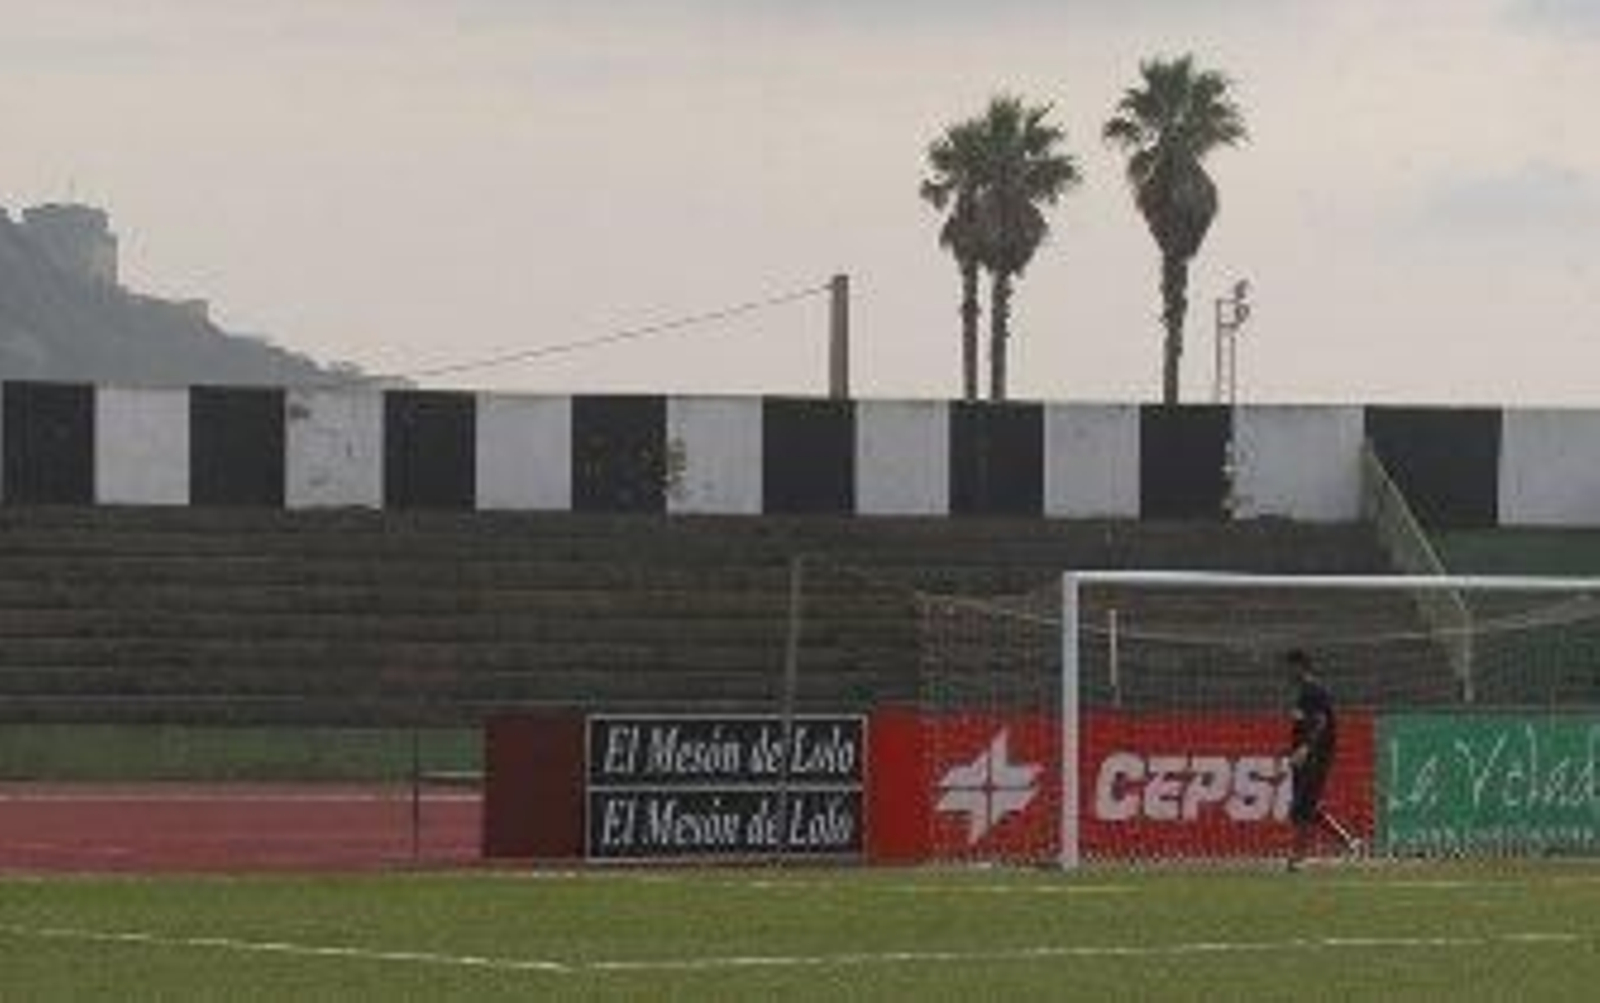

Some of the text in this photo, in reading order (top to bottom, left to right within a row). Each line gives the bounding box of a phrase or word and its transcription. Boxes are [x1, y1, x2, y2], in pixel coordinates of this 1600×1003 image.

[605, 725, 640, 773] El
[751, 726, 784, 773] de
[791, 726, 854, 773] Lolo
[603, 800, 636, 845] El
[747, 799, 781, 845] de
[790, 799, 852, 845] Lolo
